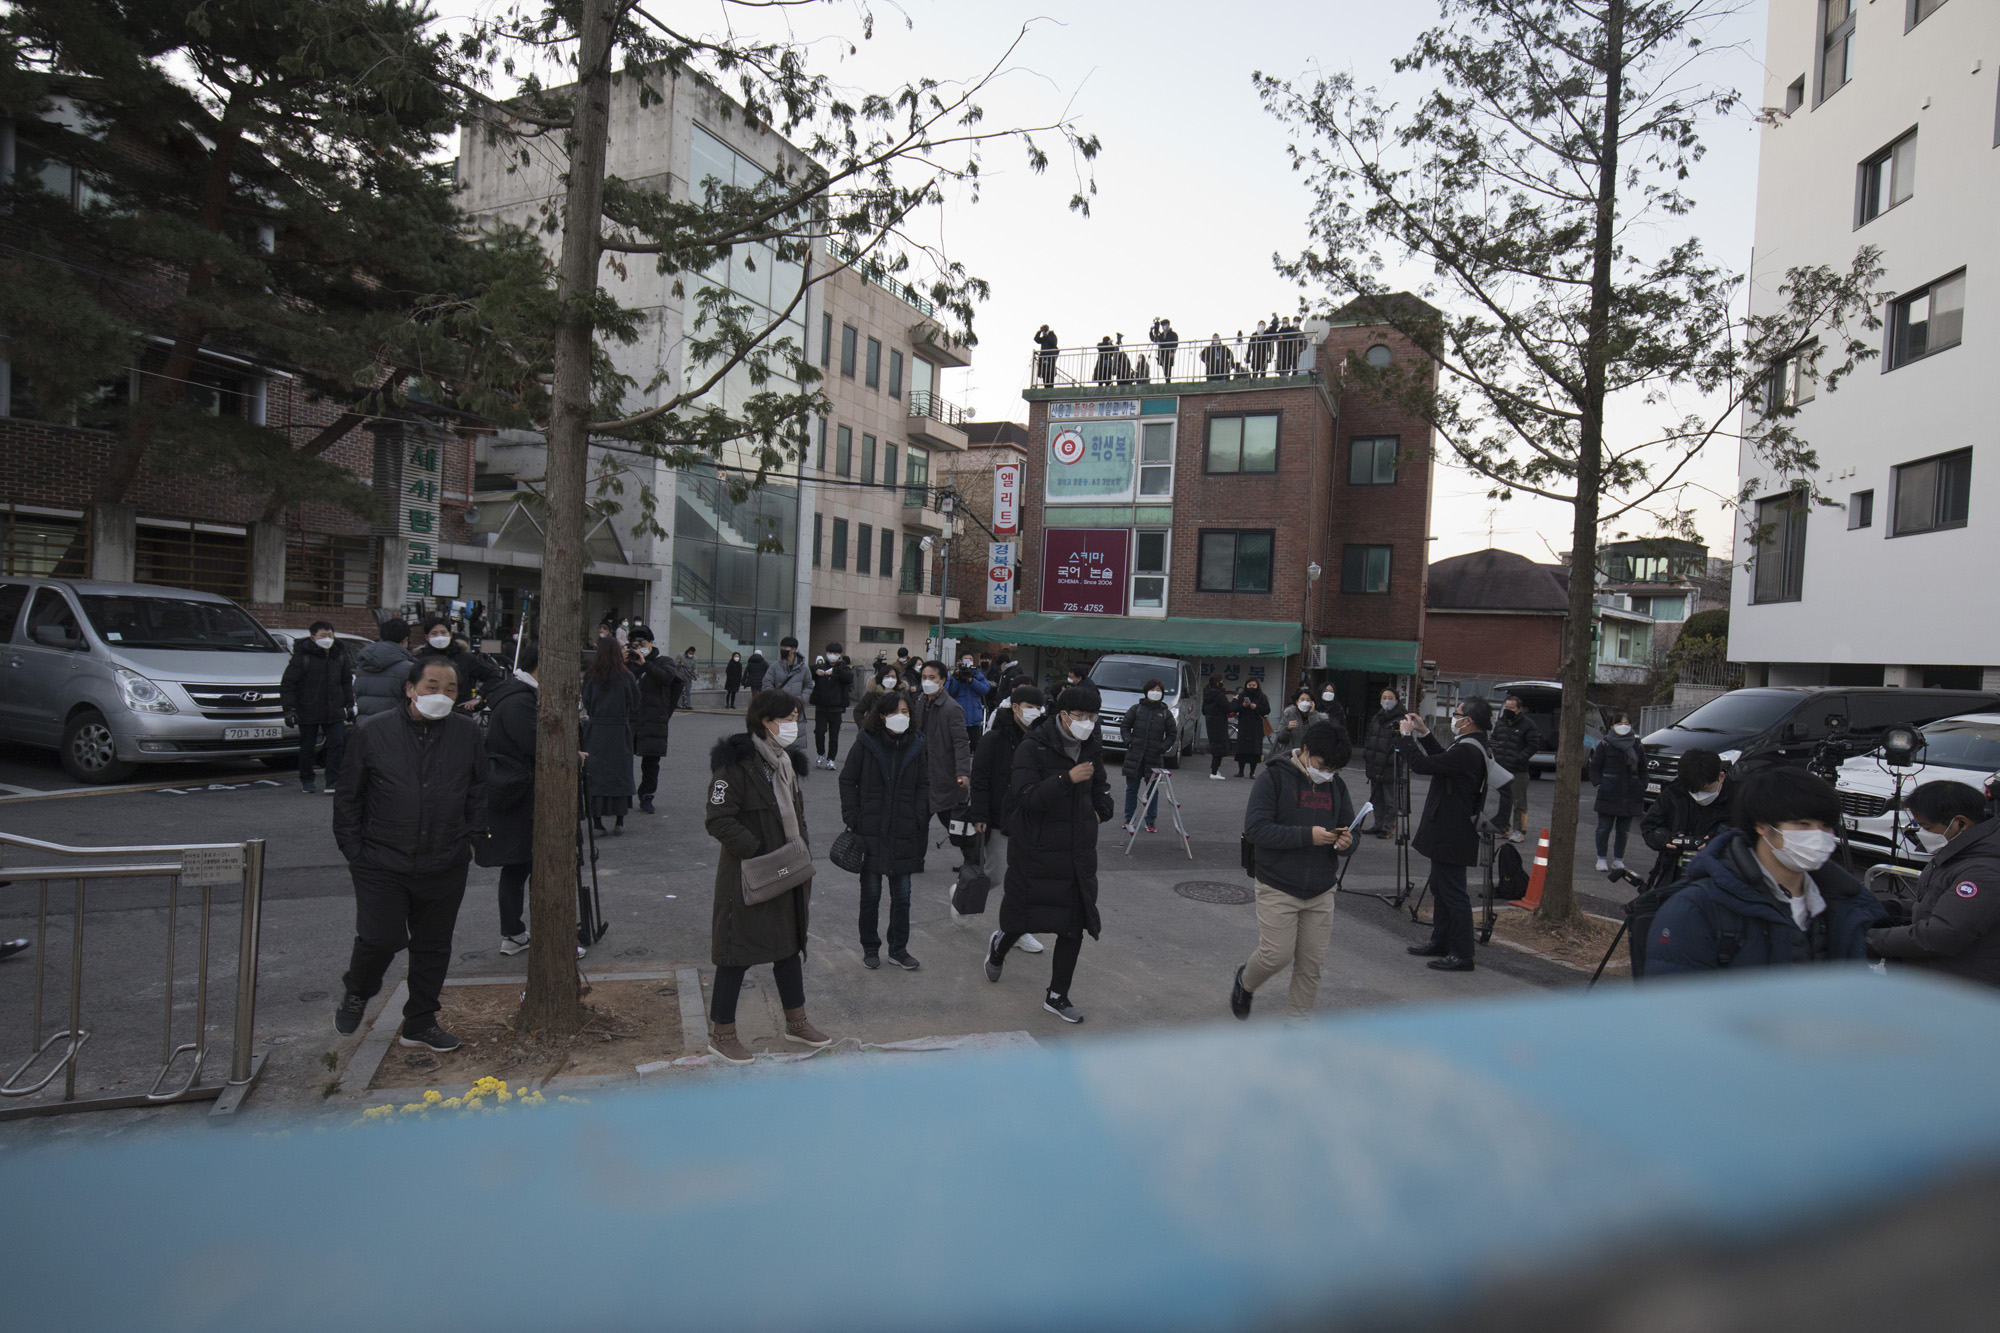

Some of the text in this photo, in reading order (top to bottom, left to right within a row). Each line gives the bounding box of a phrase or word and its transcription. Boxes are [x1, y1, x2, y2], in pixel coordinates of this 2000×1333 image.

[1051, 401, 1136, 417] 신용과 품질을 제일로 하는
[1091, 435, 1126, 461] 학생복
[1000, 472, 1013, 524] 엘리트
[407, 446, 438, 597] 새사람교회
[1069, 552, 1104, 564] 스키마
[1058, 566, 1113, 579] 국어 논술
[1084, 604, 1104, 612] 4752
[253, 728, 277, 738] 3148
